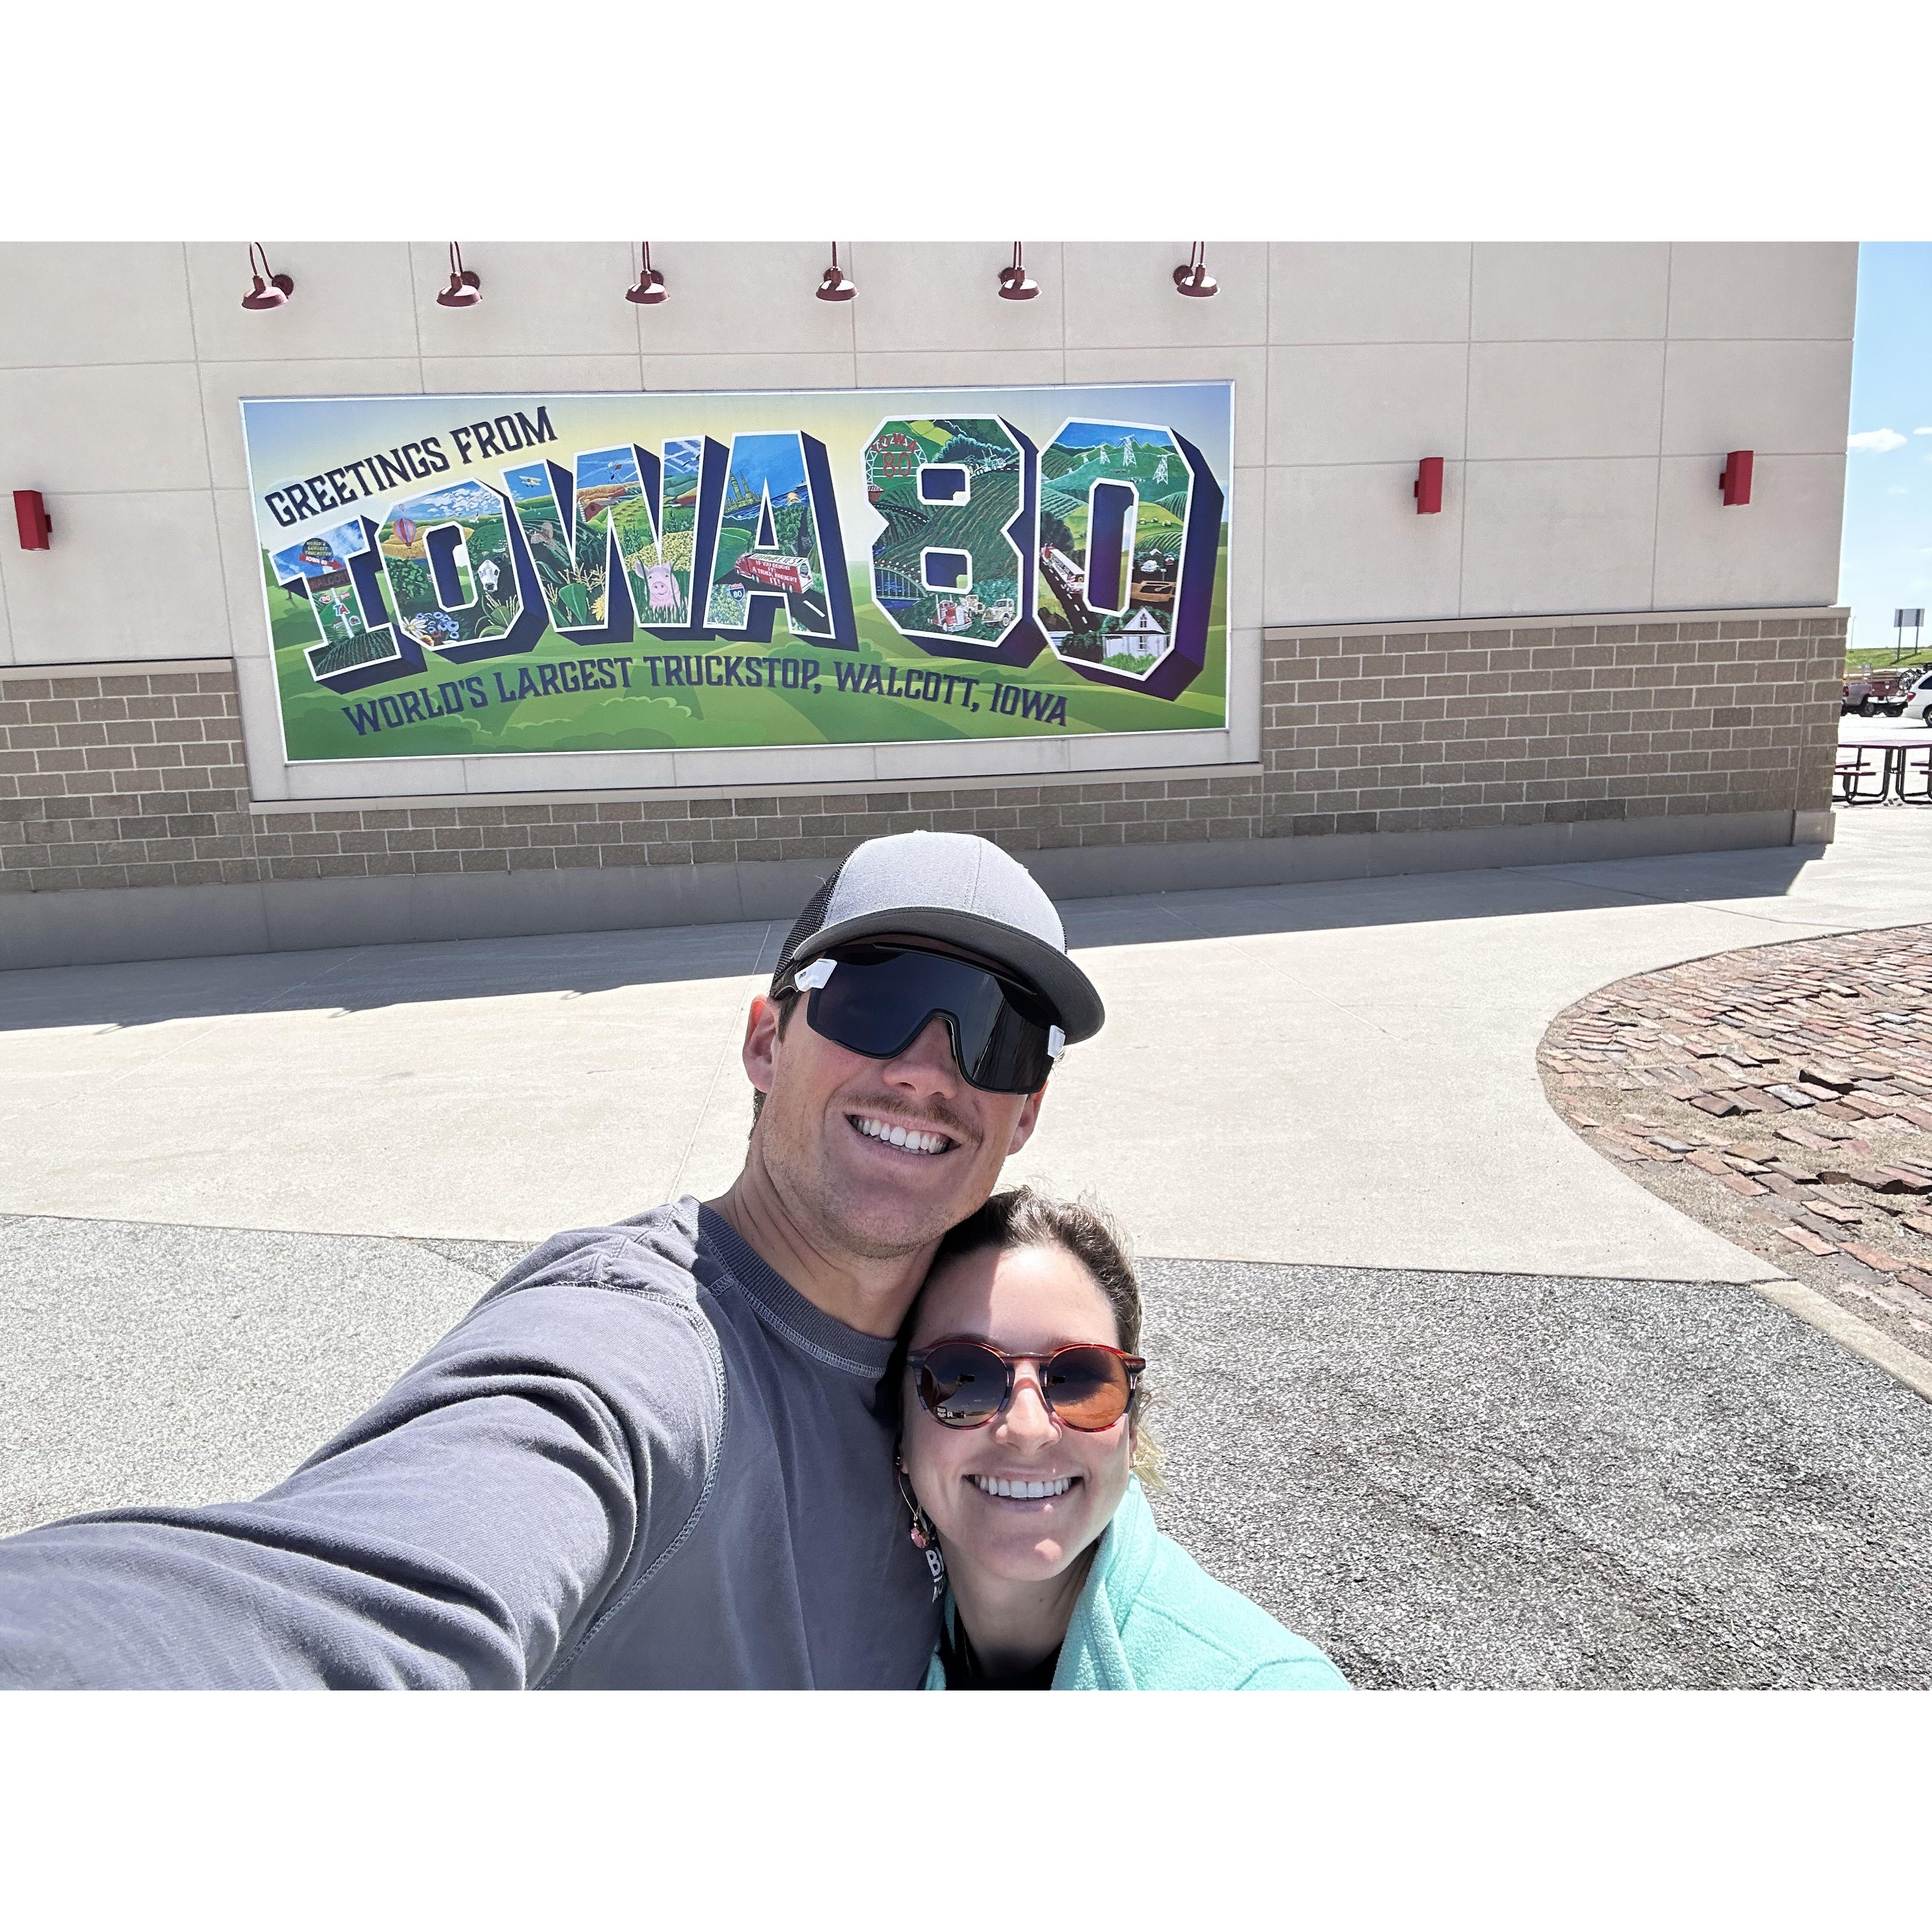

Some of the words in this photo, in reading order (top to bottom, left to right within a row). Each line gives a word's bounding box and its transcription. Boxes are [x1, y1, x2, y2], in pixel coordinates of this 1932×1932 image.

[264, 436, 450, 527] GREETINGS
[449, 405, 558, 464] FROM
[870, 433, 917, 454] IOWA
[883, 452, 911, 477] 80
[269, 429, 859, 695] IOWA
[861, 413, 1225, 702] 80
[333, 603, 350, 617] TA
[341, 677, 488, 736] WORLD'S
[494, 657, 633, 703] LARGEST
[643, 656, 822, 694] TRUCKSTOP,
[833, 661, 980, 712] WALCOTT,
[989, 683, 1068, 726] IOWA
